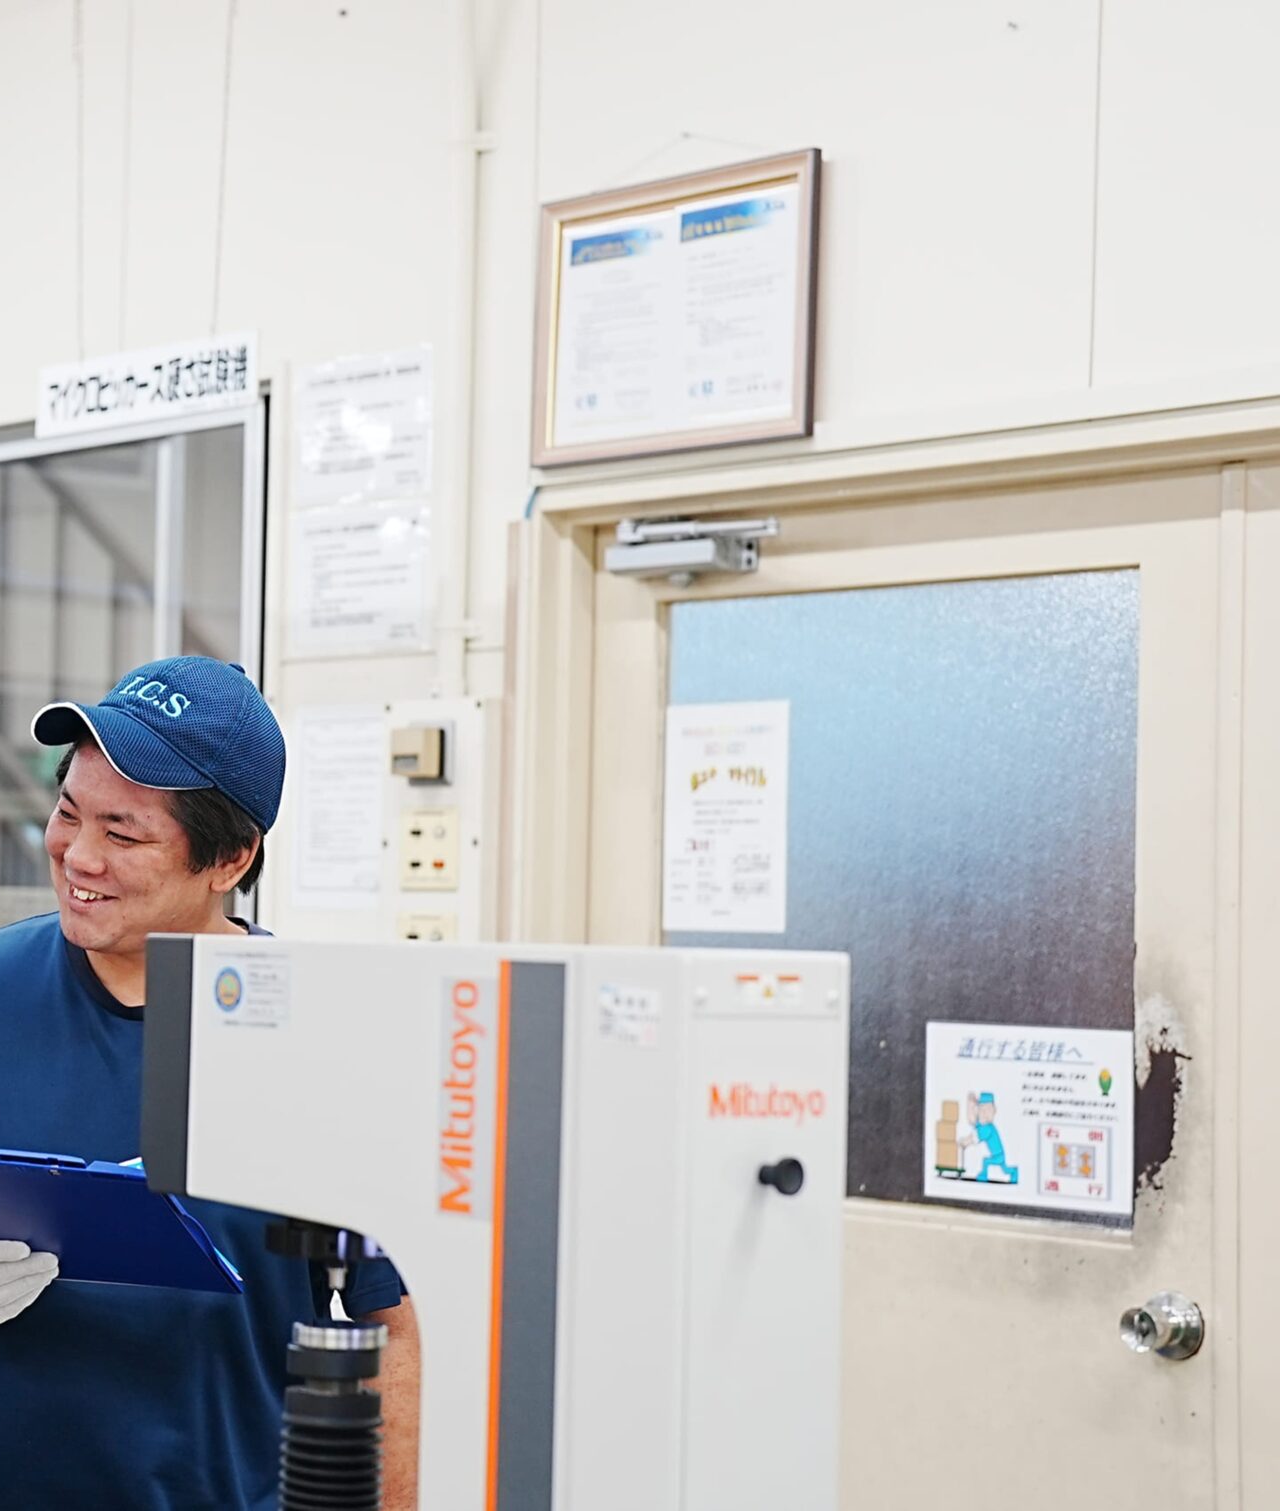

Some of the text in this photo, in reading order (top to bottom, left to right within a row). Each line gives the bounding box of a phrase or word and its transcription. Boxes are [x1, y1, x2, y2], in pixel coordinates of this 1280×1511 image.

[119, 676, 191, 717] I.C.S
[957, 1036, 1083, 1062] 通行する皆様へ
[438, 979, 487, 1214] Mitutoyo
[708, 1083, 826, 1126] Mitutoyo
